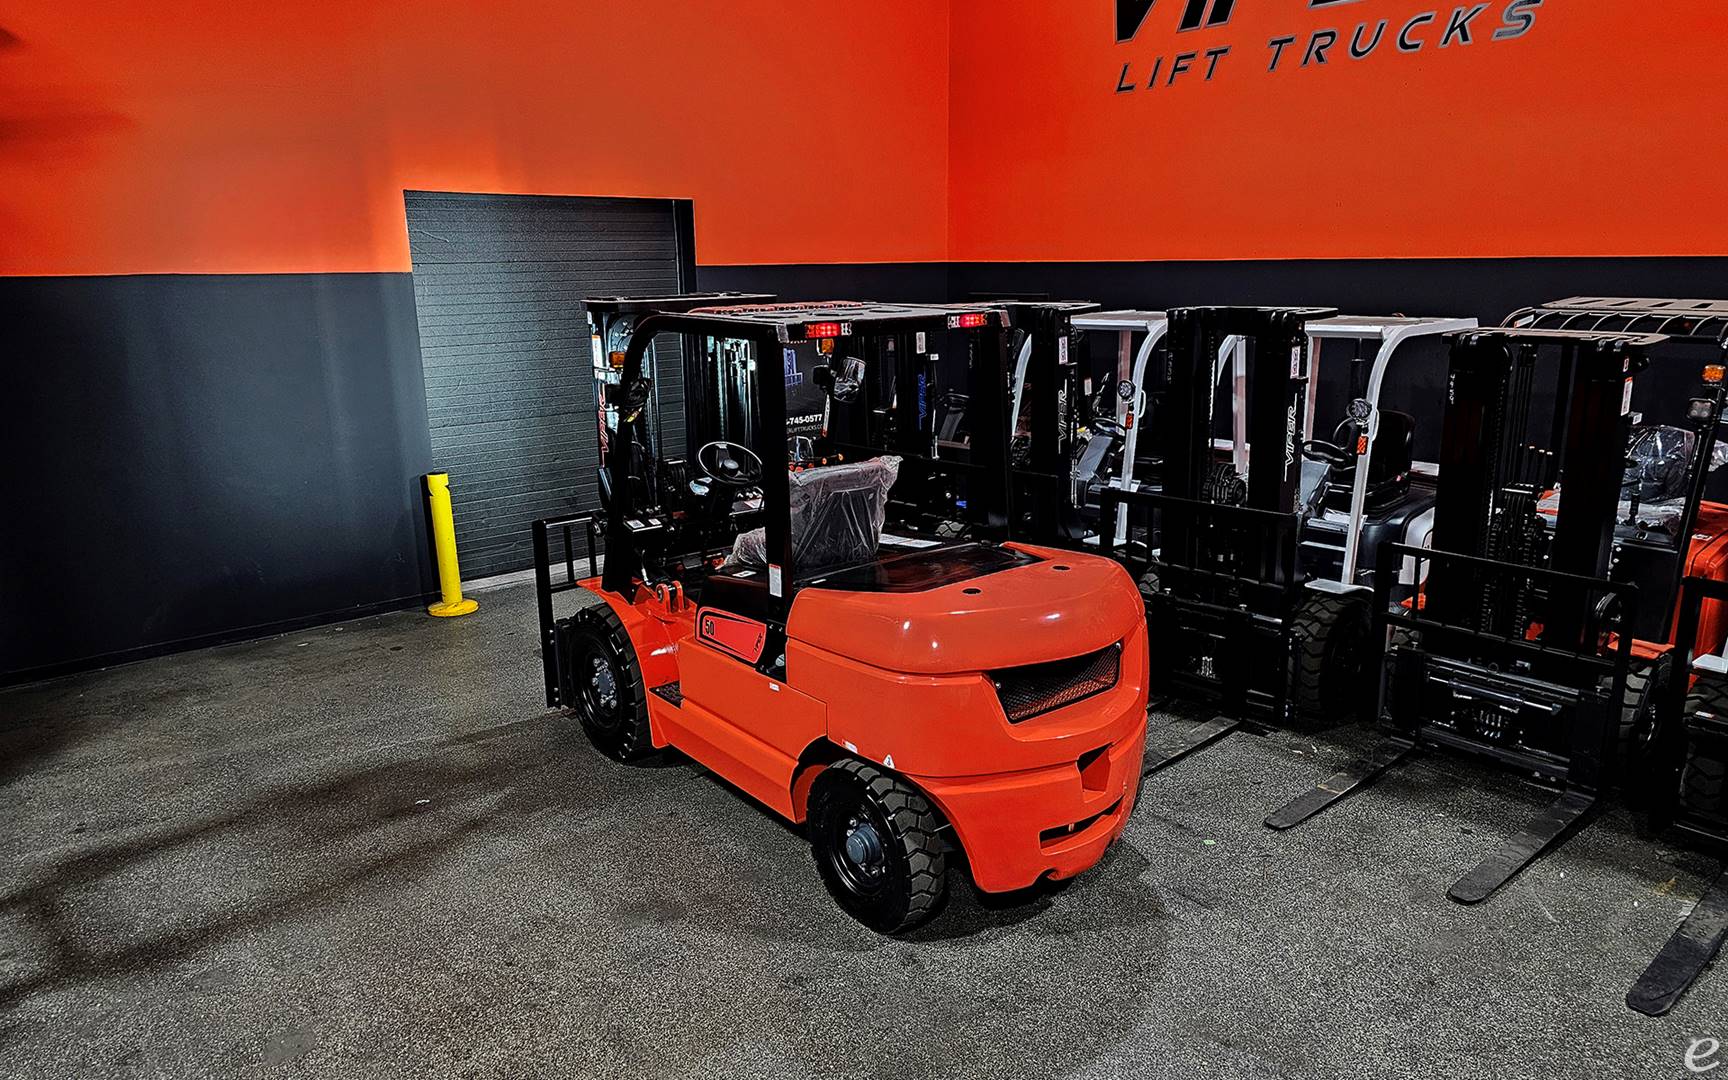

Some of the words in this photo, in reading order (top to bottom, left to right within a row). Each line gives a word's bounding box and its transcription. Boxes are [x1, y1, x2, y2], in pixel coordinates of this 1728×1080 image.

[1115, 46, 1232, 94] LIFT
[1267, 0, 1544, 72] TRUCKS
[1058, 379, 1067, 454] VIPER
[1284, 393, 1297, 482] VIPER
[705, 619, 715, 636] 50
